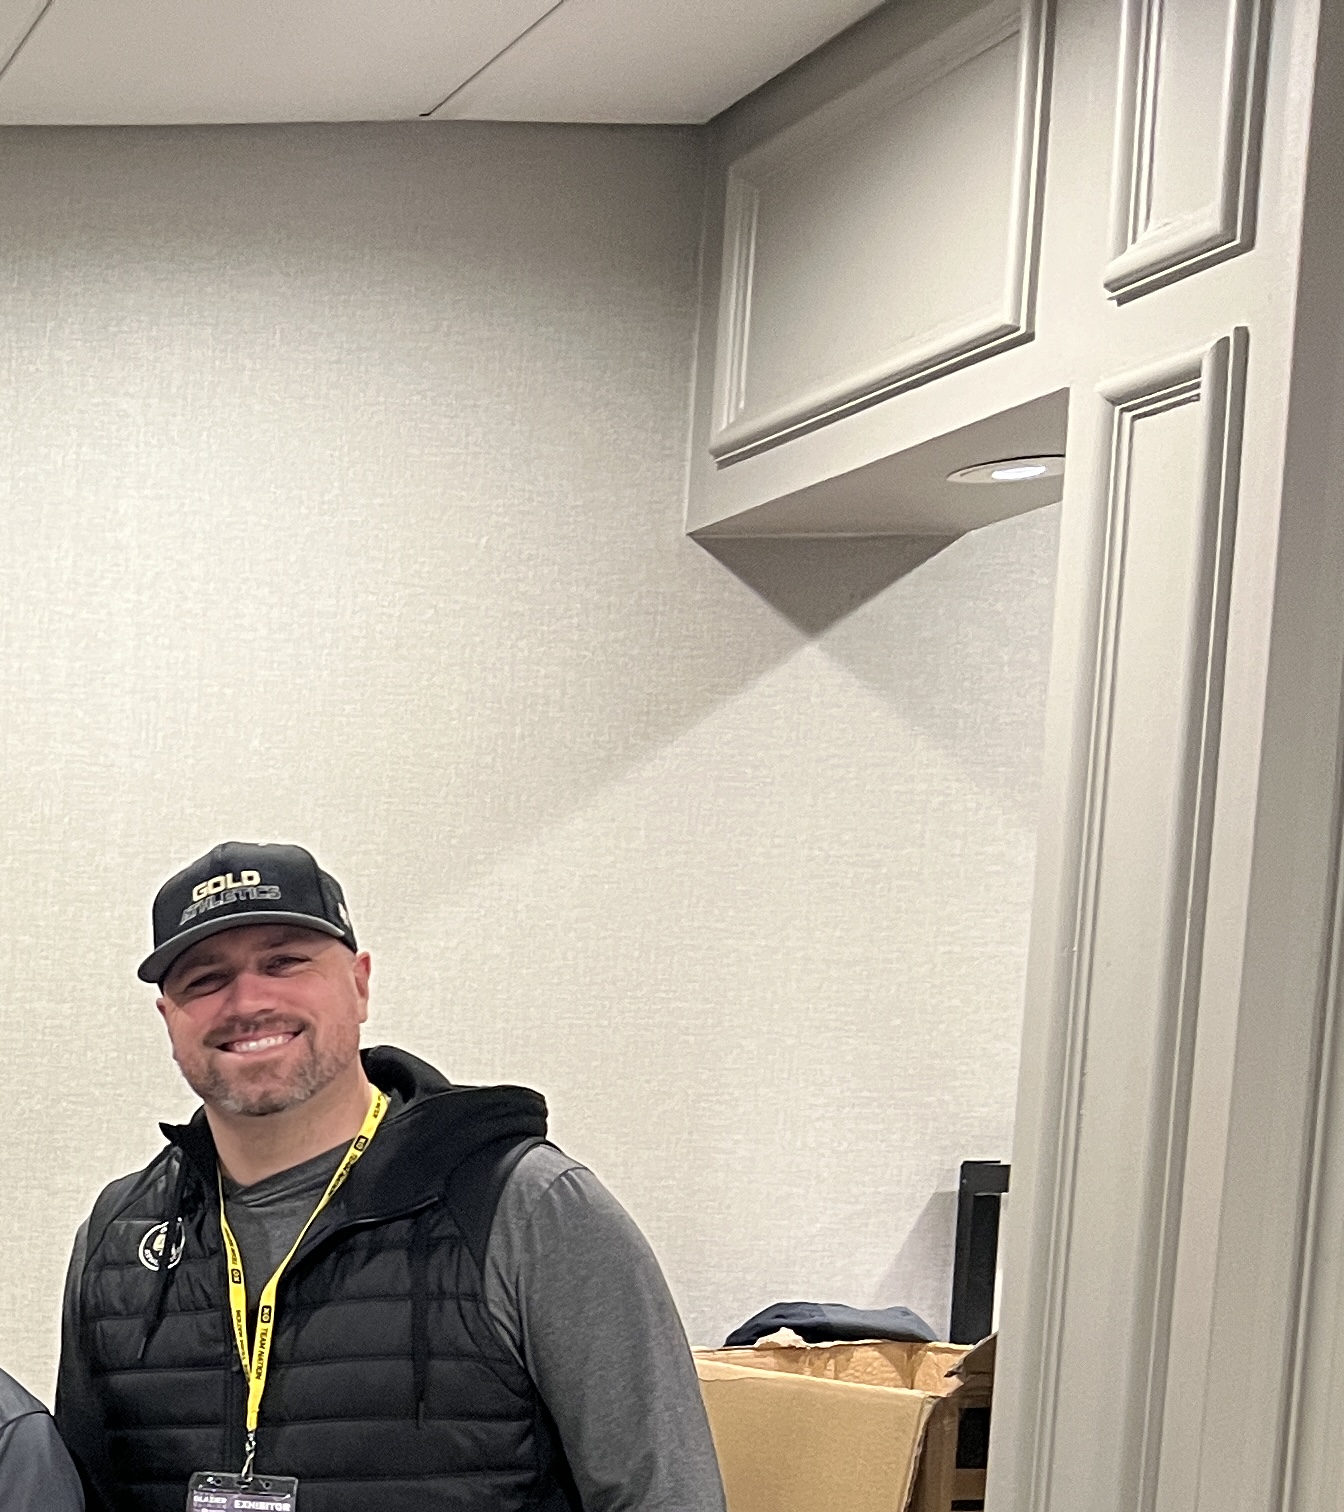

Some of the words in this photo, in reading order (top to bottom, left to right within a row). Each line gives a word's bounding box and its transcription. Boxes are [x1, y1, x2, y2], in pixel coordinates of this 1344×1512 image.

[191, 869, 262, 902] GOLD
[179, 884, 282, 926] ATHLETICS
[254, 1347, 268, 1380] NATION
[234, 1499, 291, 1512] EXHIBITOR
